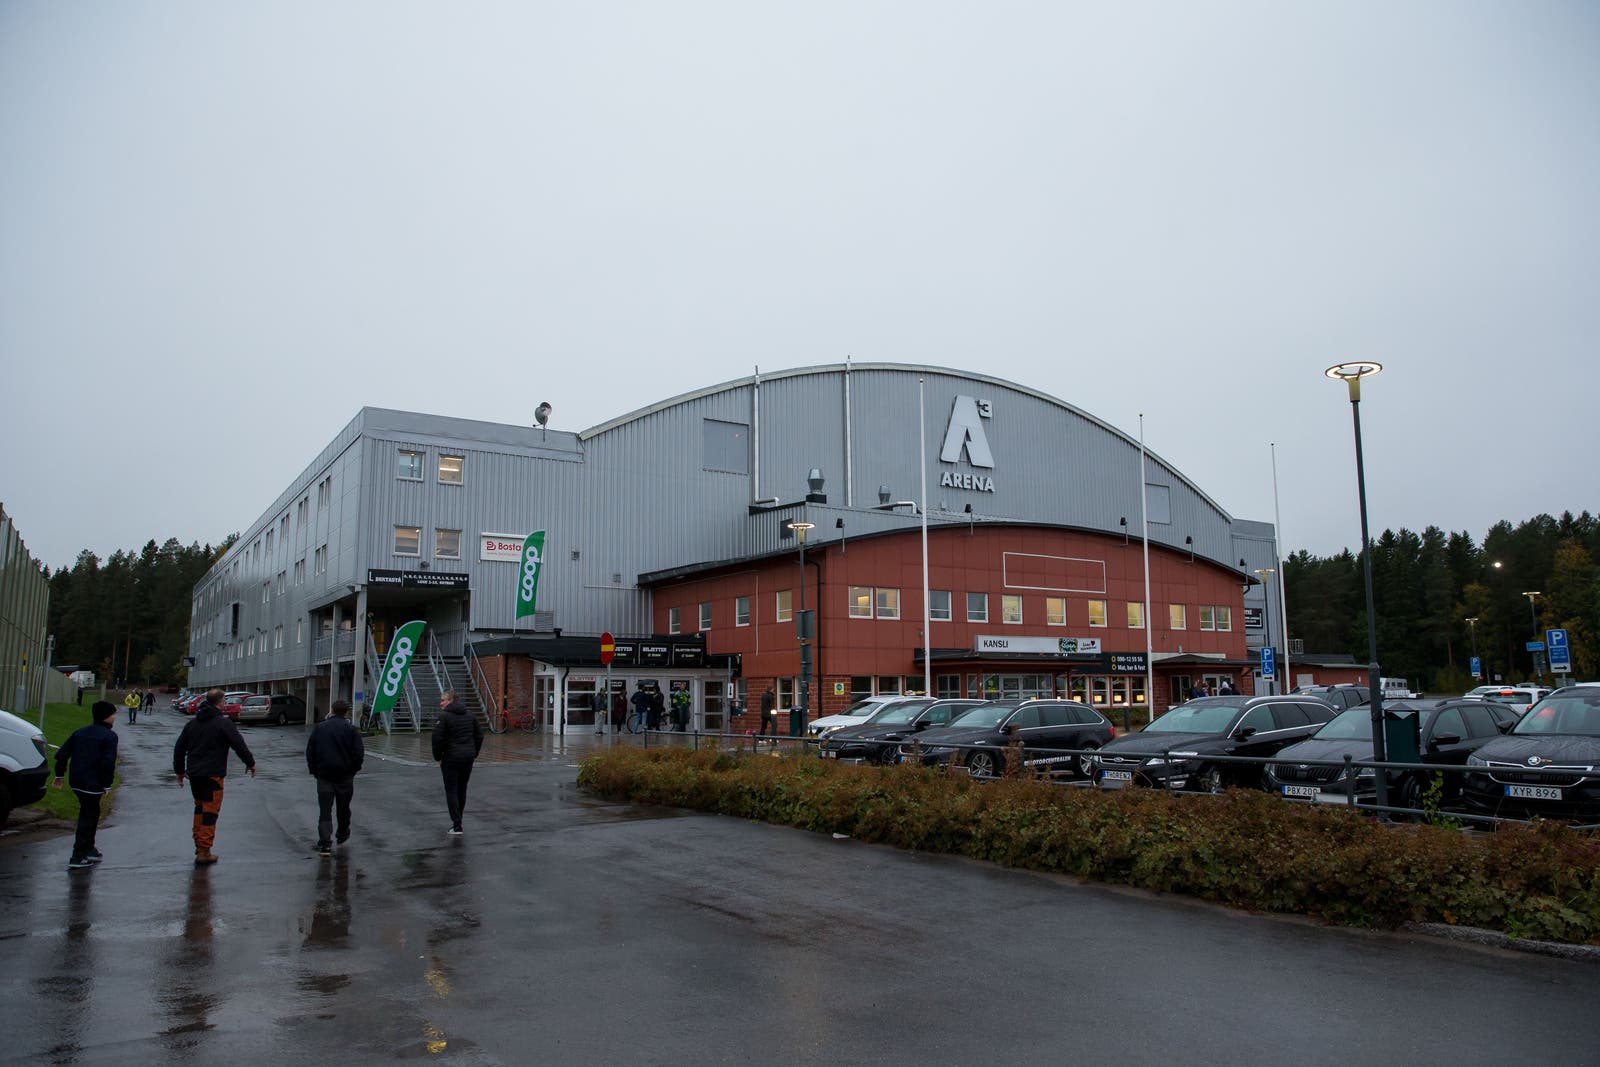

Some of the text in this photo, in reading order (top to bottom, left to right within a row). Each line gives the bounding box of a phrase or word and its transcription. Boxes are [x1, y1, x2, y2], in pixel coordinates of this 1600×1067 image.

[940, 471, 995, 492] ARENA
[498, 542, 521, 551] Bosta
[521, 545, 540, 602] coop
[984, 639, 1008, 648] KANSLI
[1552, 631, 1563, 646] P
[1263, 648, 1271, 660] P
[383, 637, 413, 697] coop
[1286, 786, 1301, 796] PBX
[1513, 787, 1557, 798] XYR 896
